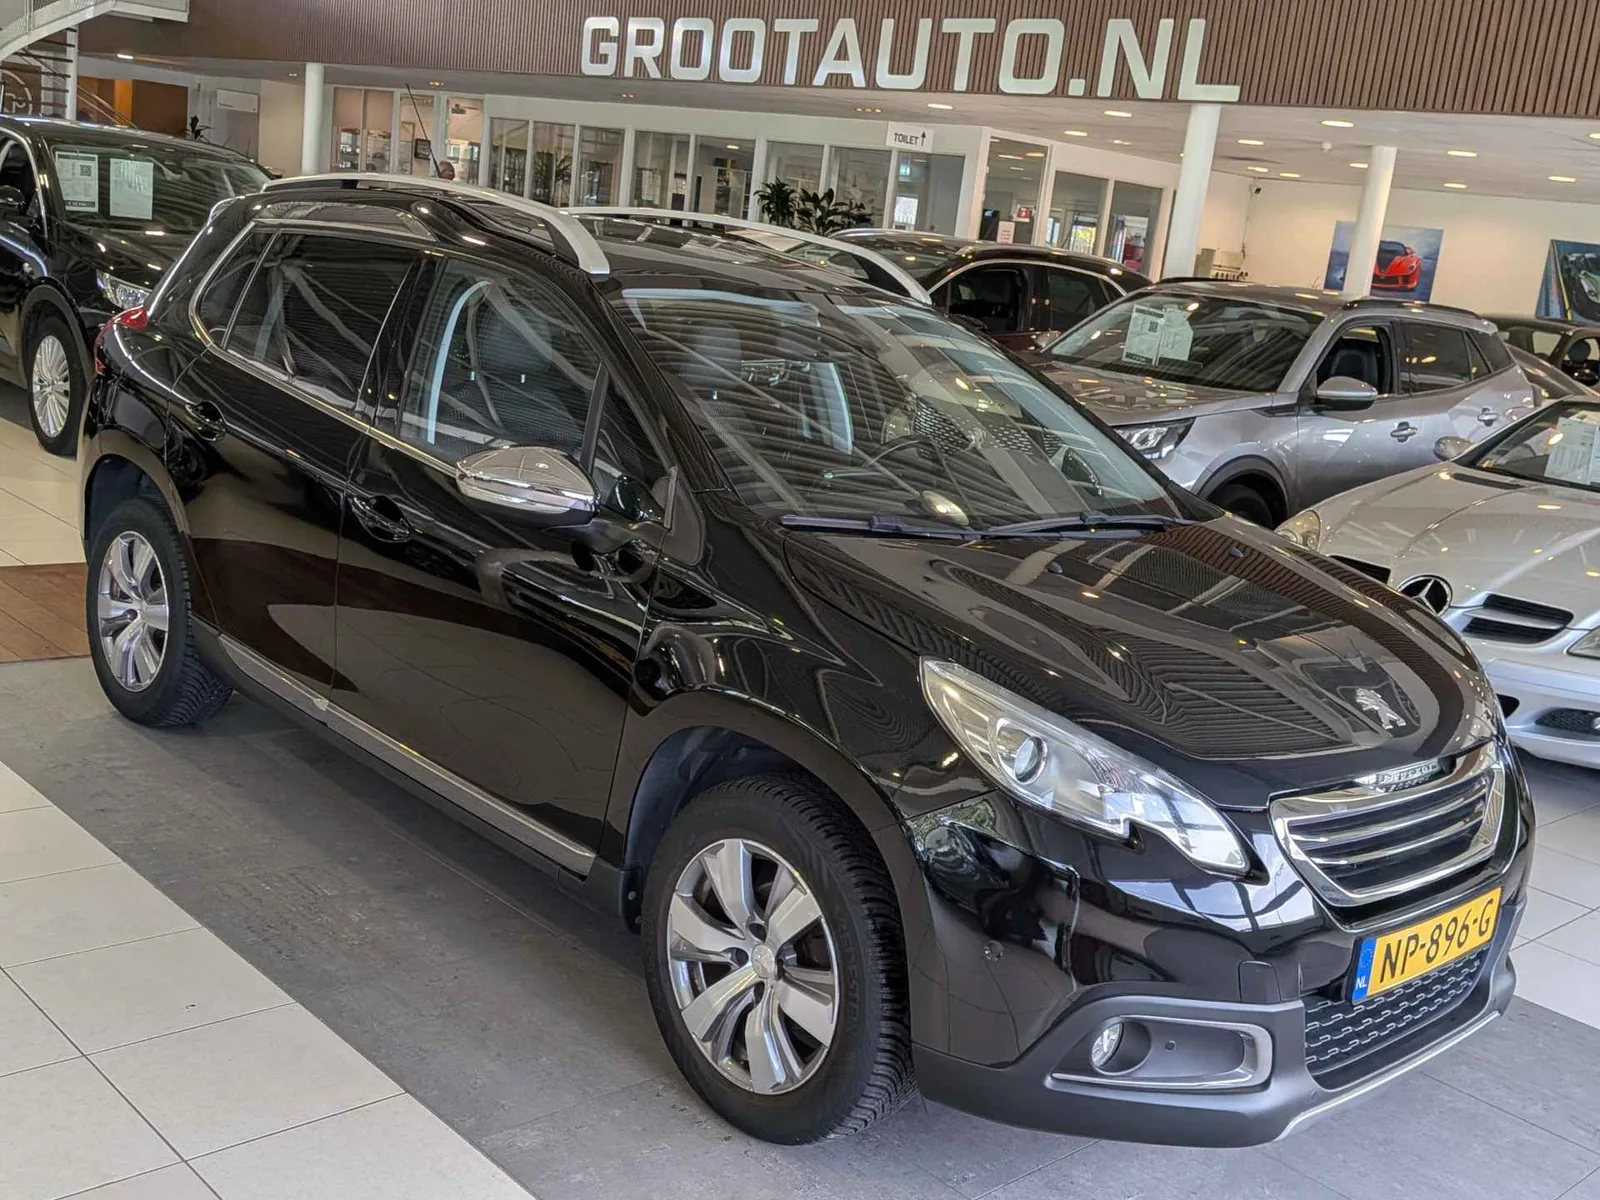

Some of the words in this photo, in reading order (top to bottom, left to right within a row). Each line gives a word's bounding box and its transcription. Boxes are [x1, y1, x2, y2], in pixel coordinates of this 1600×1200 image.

[581, 16, 1240, 102] GROOTAUTO.NL
[894, 132, 919, 146] TOILET
[1379, 898, 1494, 984] NP-896-G
[1355, 977, 1368, 990] NL
